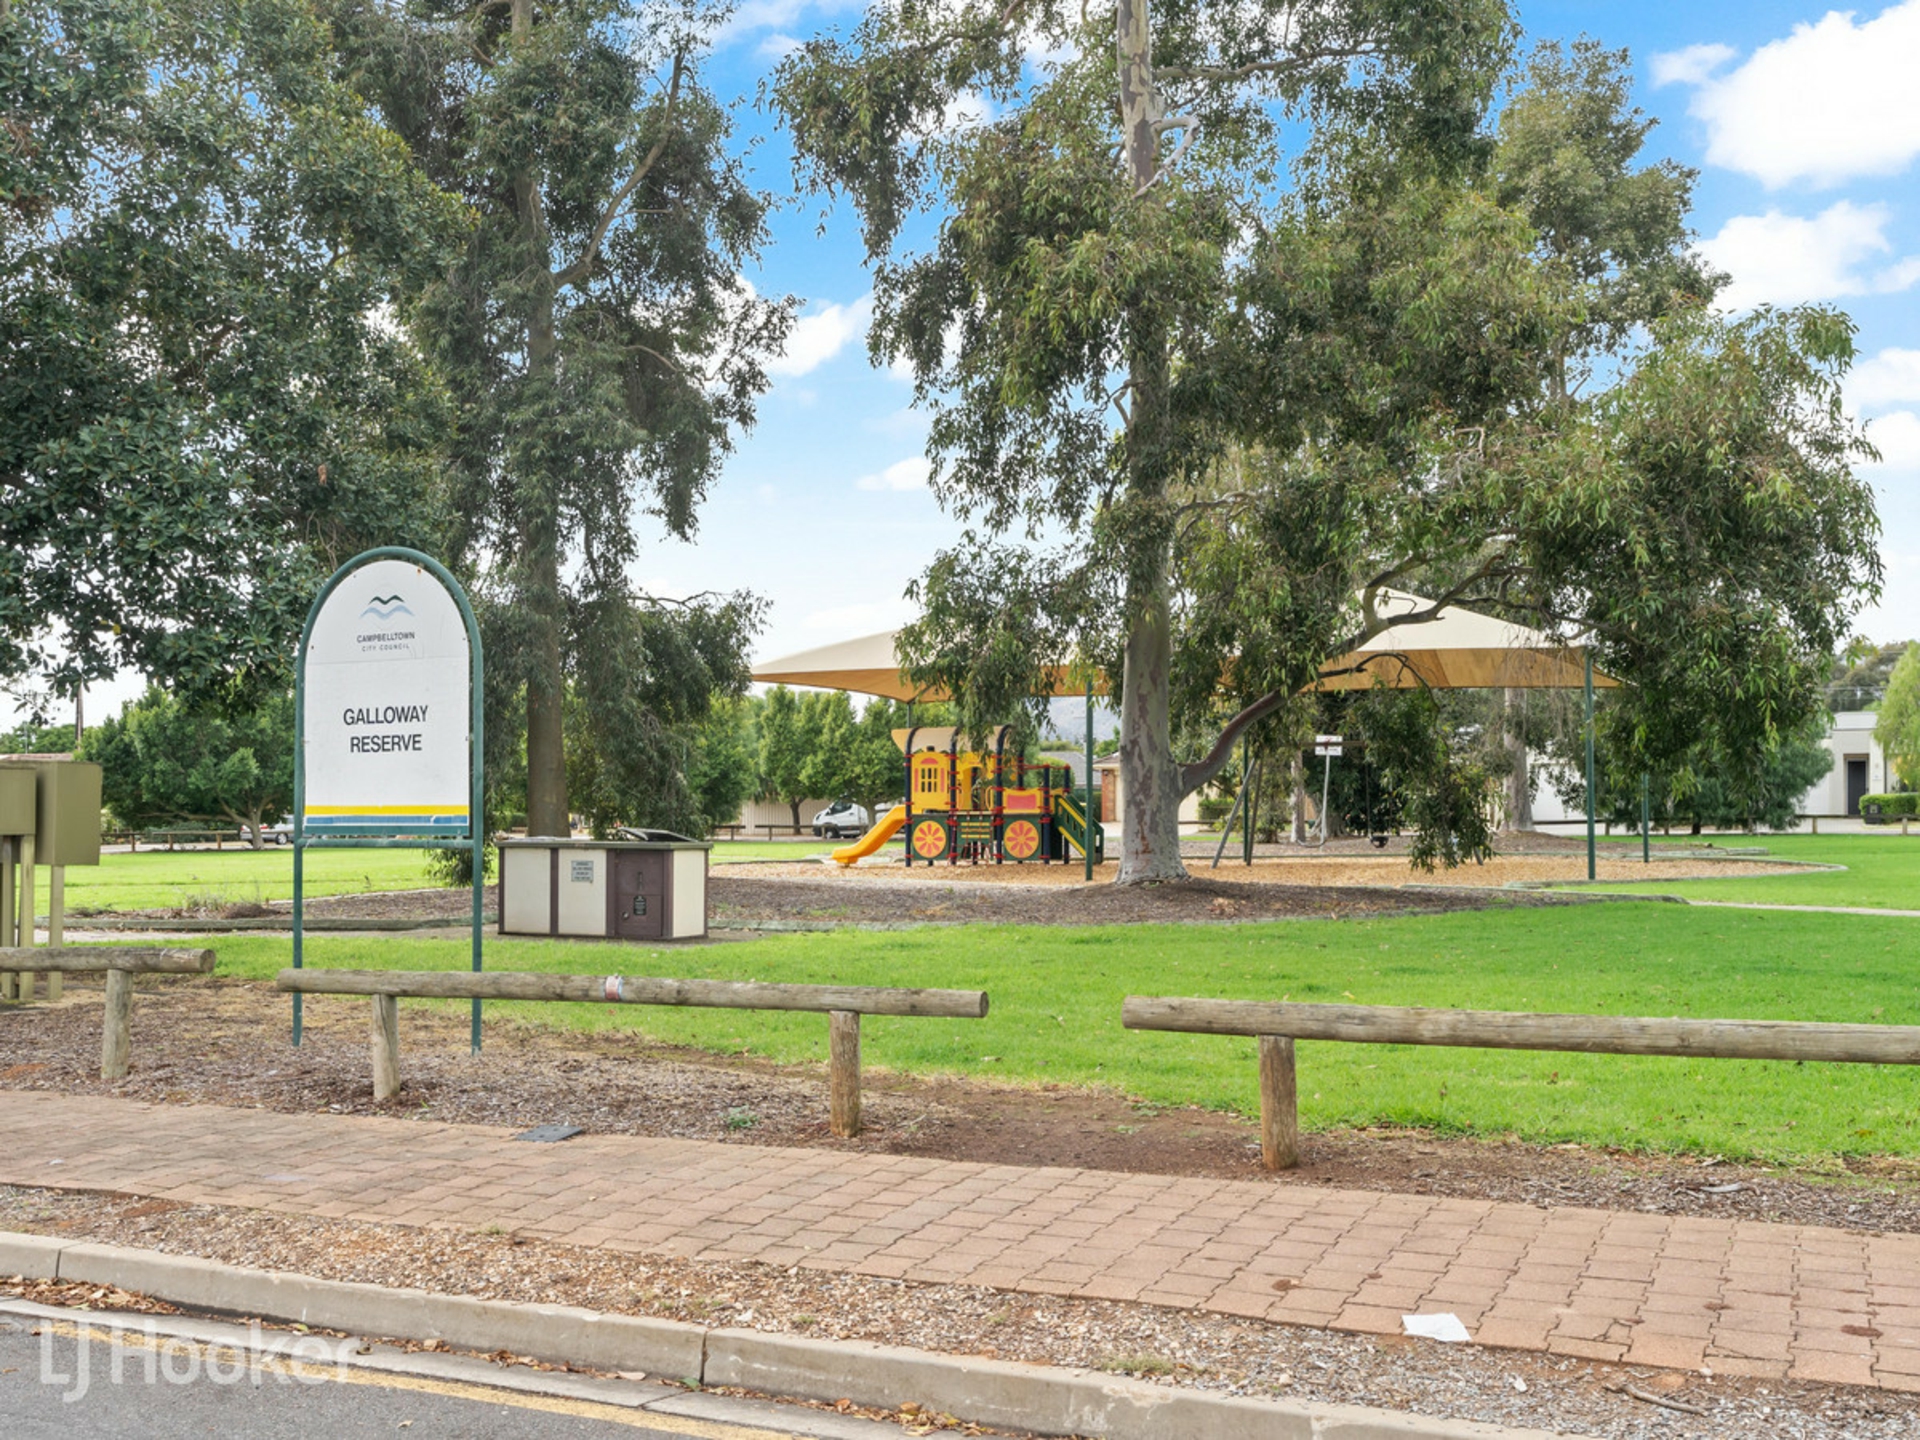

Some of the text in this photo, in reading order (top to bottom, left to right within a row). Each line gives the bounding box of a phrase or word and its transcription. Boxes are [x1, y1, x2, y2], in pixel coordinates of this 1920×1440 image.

[356, 632, 415, 643] CAMPBELLTOWN
[379, 643, 410, 651] COUNCIL
[343, 705, 429, 726] GALLOWAY
[350, 734, 422, 753] RESERVE
